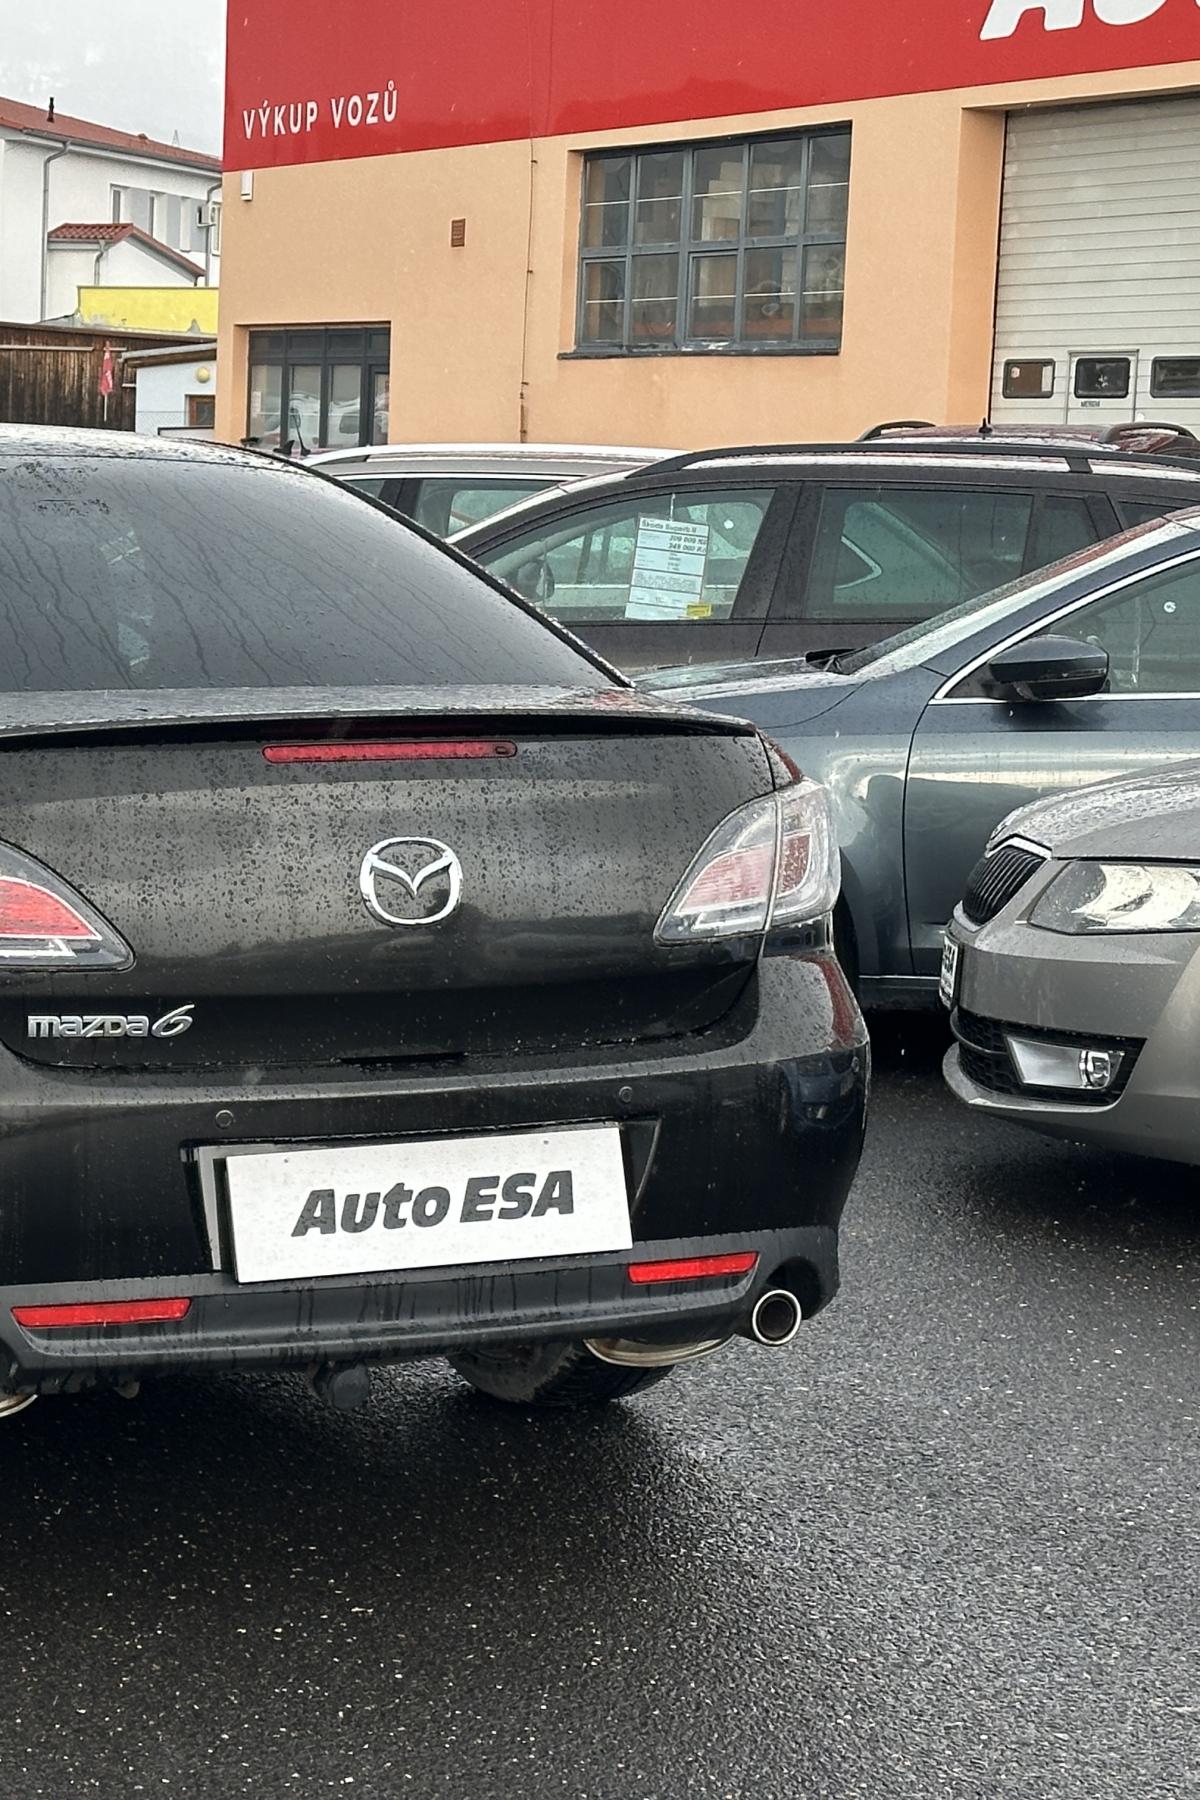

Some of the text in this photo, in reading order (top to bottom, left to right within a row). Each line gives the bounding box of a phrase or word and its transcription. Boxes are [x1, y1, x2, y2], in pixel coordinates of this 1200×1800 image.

[243, 80, 398, 139] VÝKUP VOZŮ
[291, 1170, 574, 1237] Auto ESA
